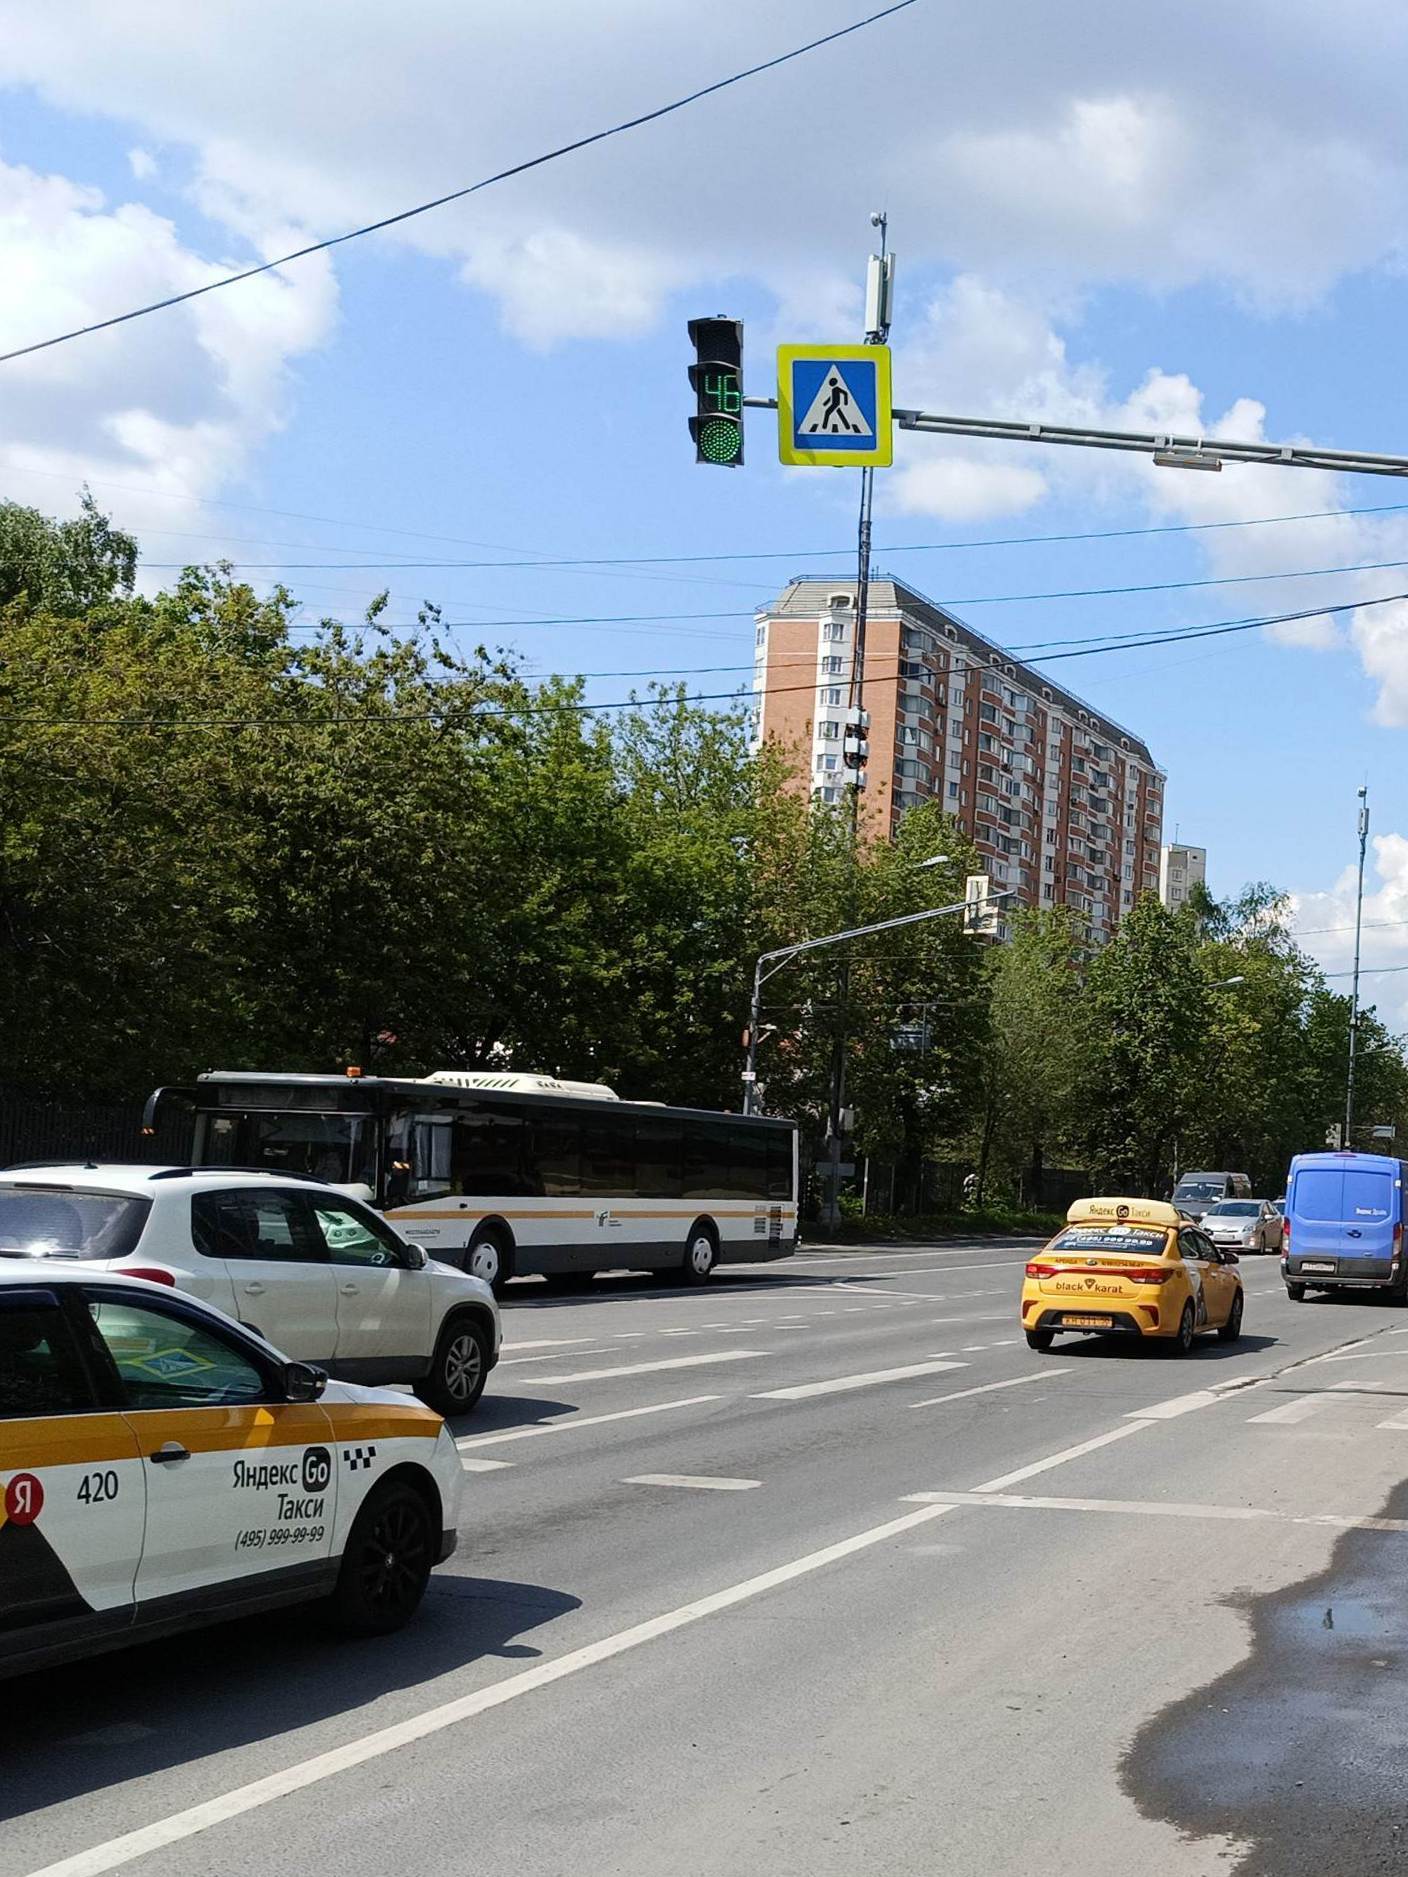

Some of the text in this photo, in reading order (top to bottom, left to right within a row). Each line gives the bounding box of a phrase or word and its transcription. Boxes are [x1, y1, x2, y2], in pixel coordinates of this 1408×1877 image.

[704, 374, 740, 412] 46
[1089, 1204, 1115, 1216] Яндекс
[1117, 1205, 1129, 1217] Go
[1055, 1281, 1123, 1294] black karat
[77, 1470, 120, 1505] 420
[233, 1452, 329, 1491] Яндекс Go
[14, 1479, 32, 1515] Я
[277, 1492, 324, 1522] Такси
[234, 1525, 325, 1552] (495) 999-99-99
